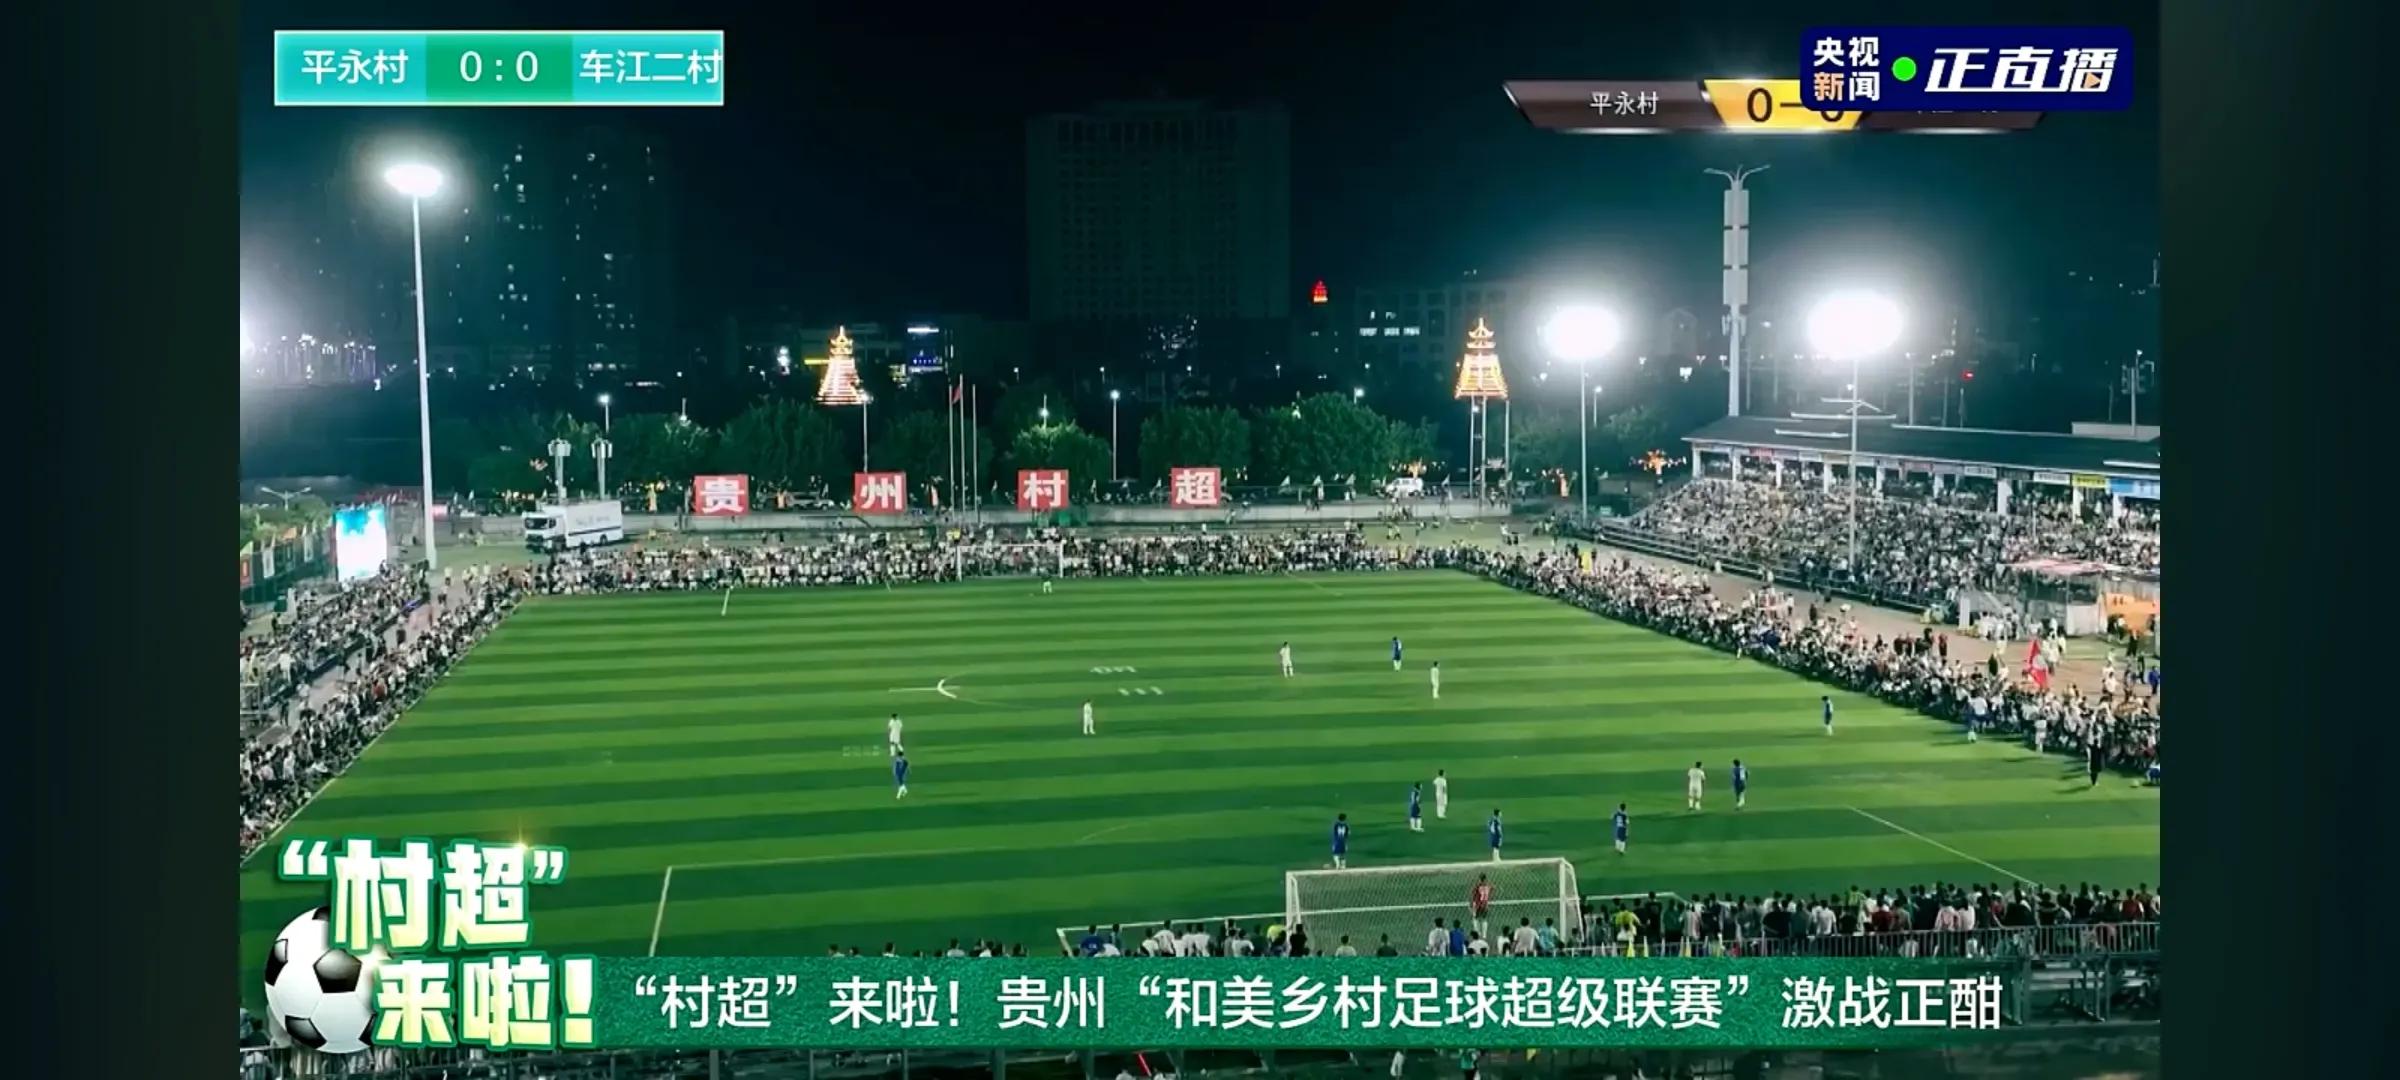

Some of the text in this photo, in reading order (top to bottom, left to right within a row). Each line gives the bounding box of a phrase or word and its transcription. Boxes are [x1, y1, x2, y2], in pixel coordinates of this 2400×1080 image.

[700, 468, 1219, 513] 贵 州 村 超
